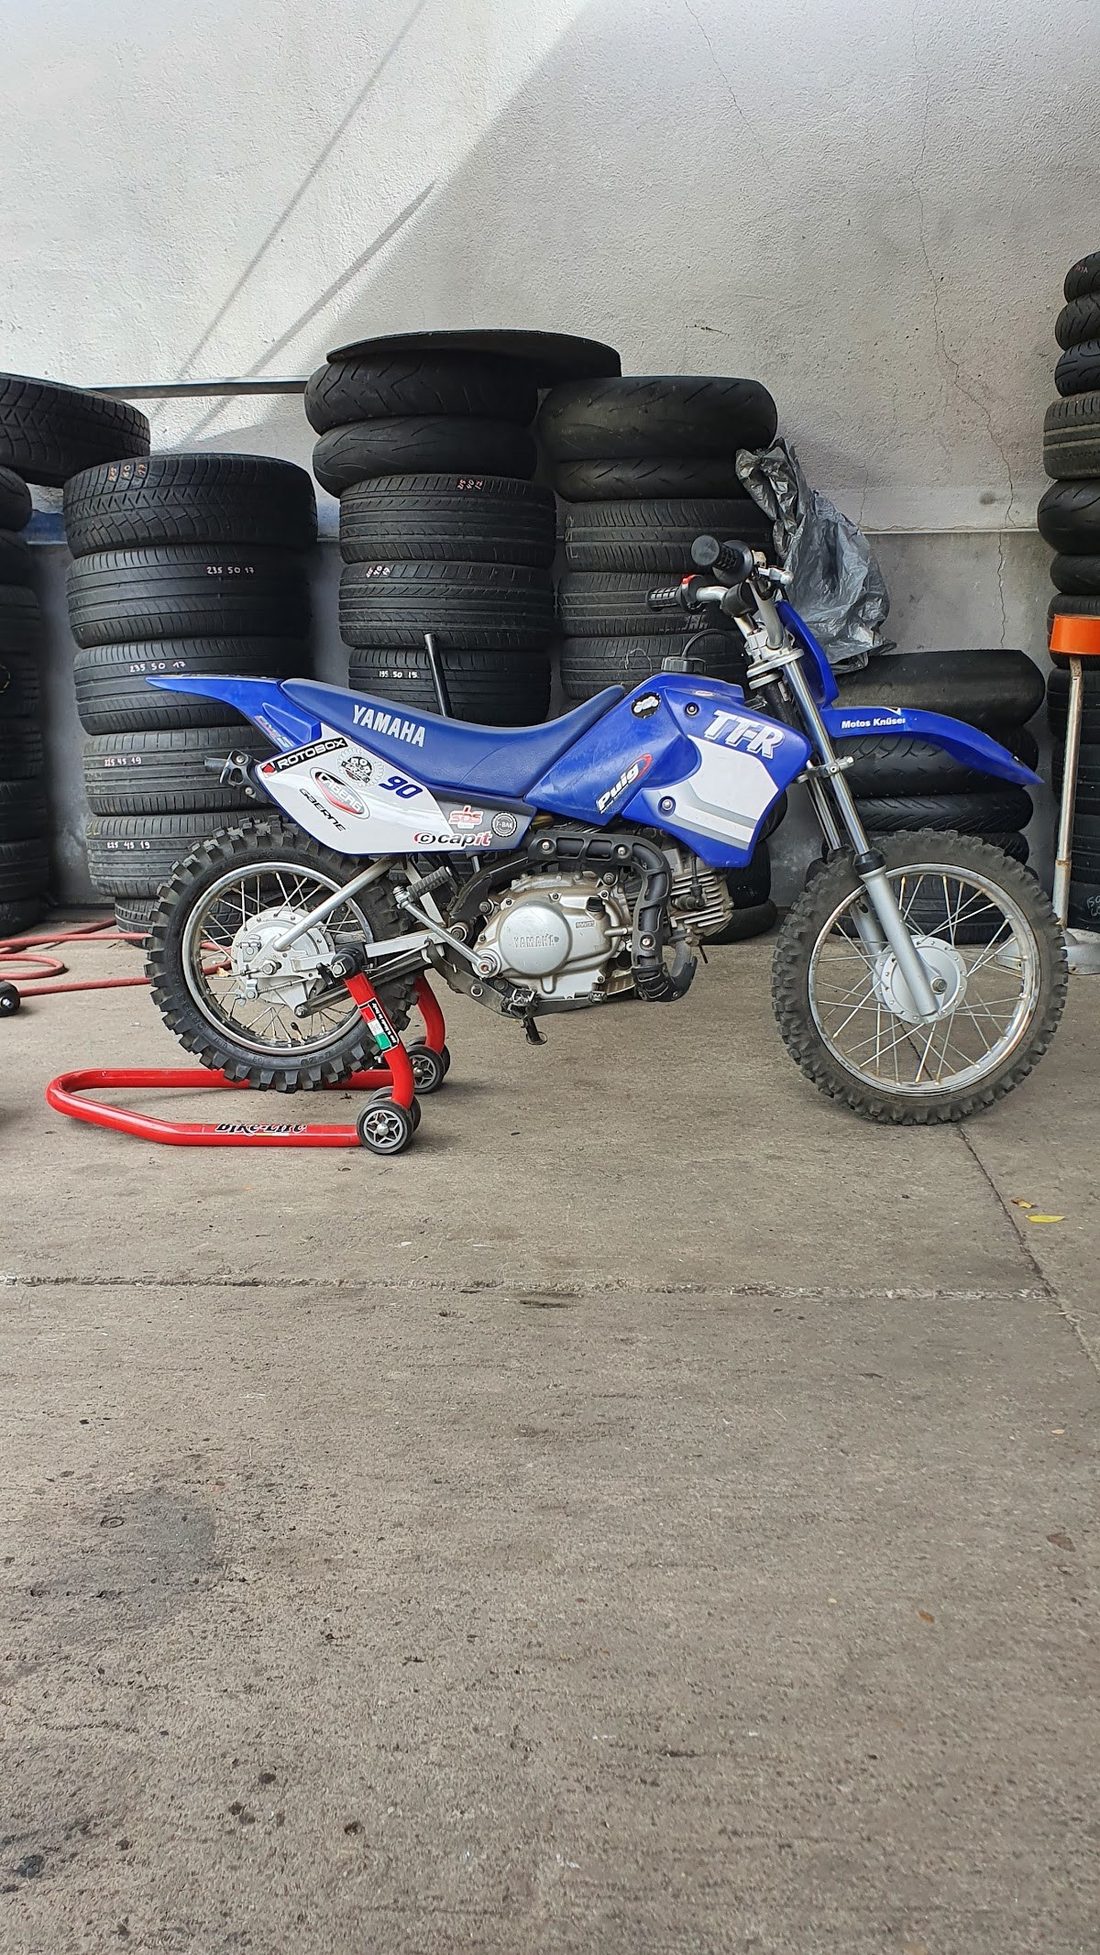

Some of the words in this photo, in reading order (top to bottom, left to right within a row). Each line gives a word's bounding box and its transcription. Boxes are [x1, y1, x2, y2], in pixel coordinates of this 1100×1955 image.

[206, 566, 223, 575] 235
[227, 566, 241, 575] 50
[244, 566, 255, 575] 17
[129, 663, 146, 673] 235
[150, 662, 166, 671] 50
[172, 660, 187, 669] 17
[352, 704, 426, 748] YAMAHA
[841, 719, 871, 729] Motos
[277, 738, 346, 770] ROTOBOX
[317, 772, 365, 813] CABERG
[379, 775, 424, 800] 90
[596, 763, 640, 814] Puig
[299, 788, 347, 832] GAERNE
[513, 933, 556, 948] YAMAHA
